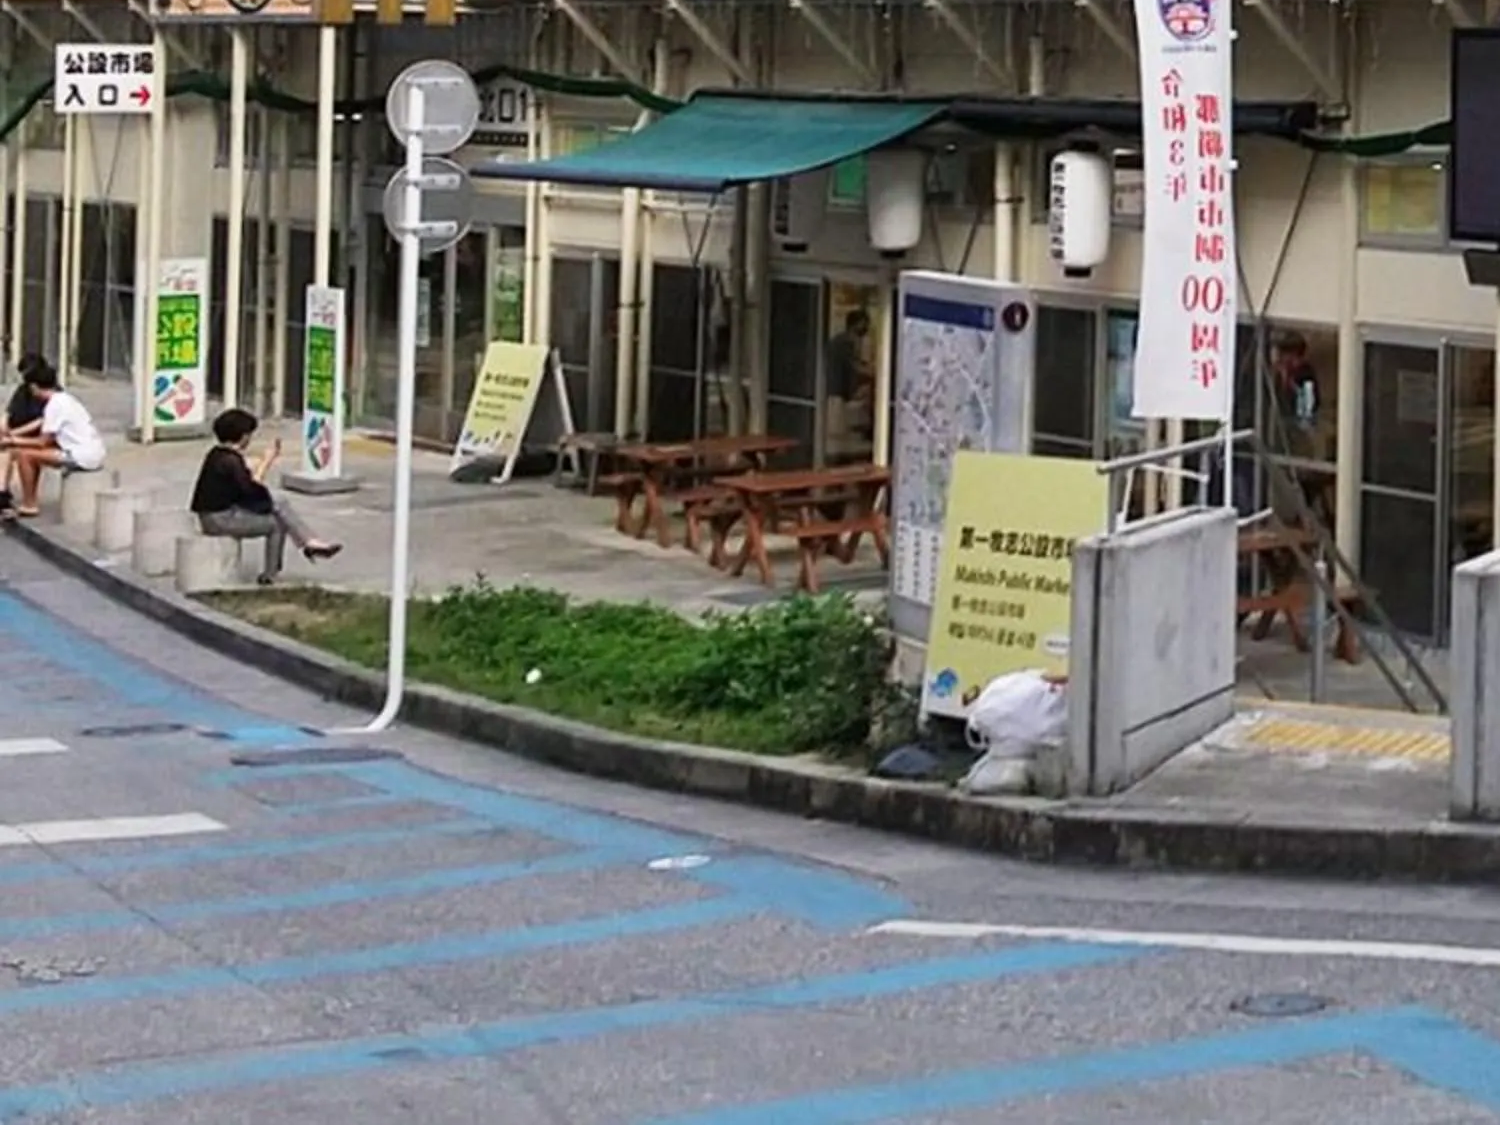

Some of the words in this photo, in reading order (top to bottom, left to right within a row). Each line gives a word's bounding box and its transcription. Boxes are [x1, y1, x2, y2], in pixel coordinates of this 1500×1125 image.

[64, 52, 154, 74] 公設市場
[64, 84, 118, 106] 入口
[1034, 574, 1071, 596] Marke
